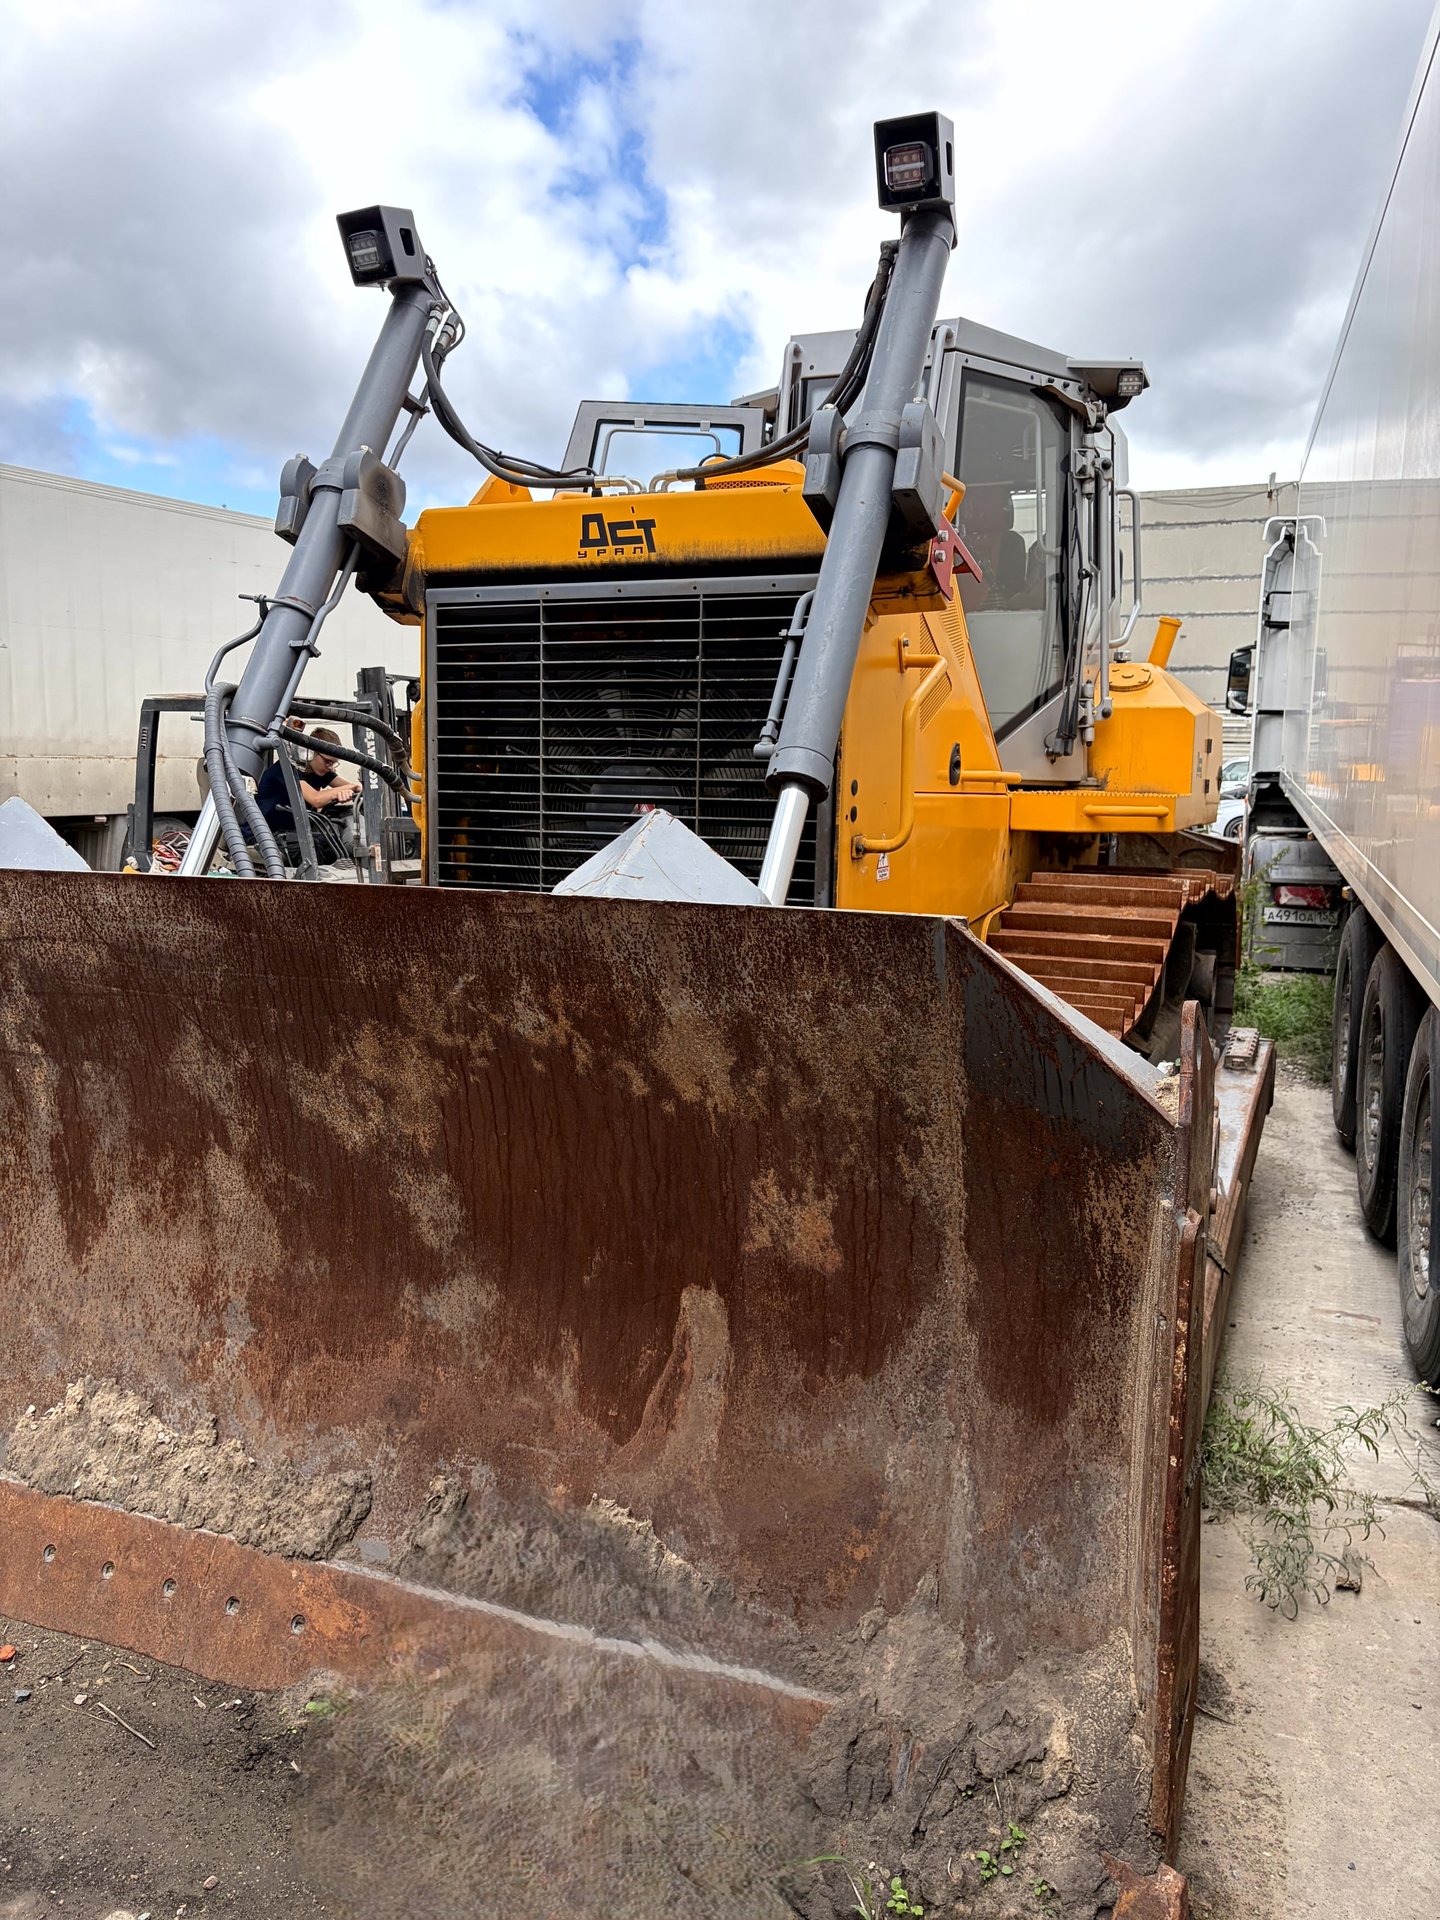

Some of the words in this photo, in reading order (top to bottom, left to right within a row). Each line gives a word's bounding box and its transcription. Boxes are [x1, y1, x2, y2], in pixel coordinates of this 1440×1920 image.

[577, 546, 643, 558] УРАЛ
[579, 513, 656, 553] ДСТ
[365, 728, 379, 790] KOATS
